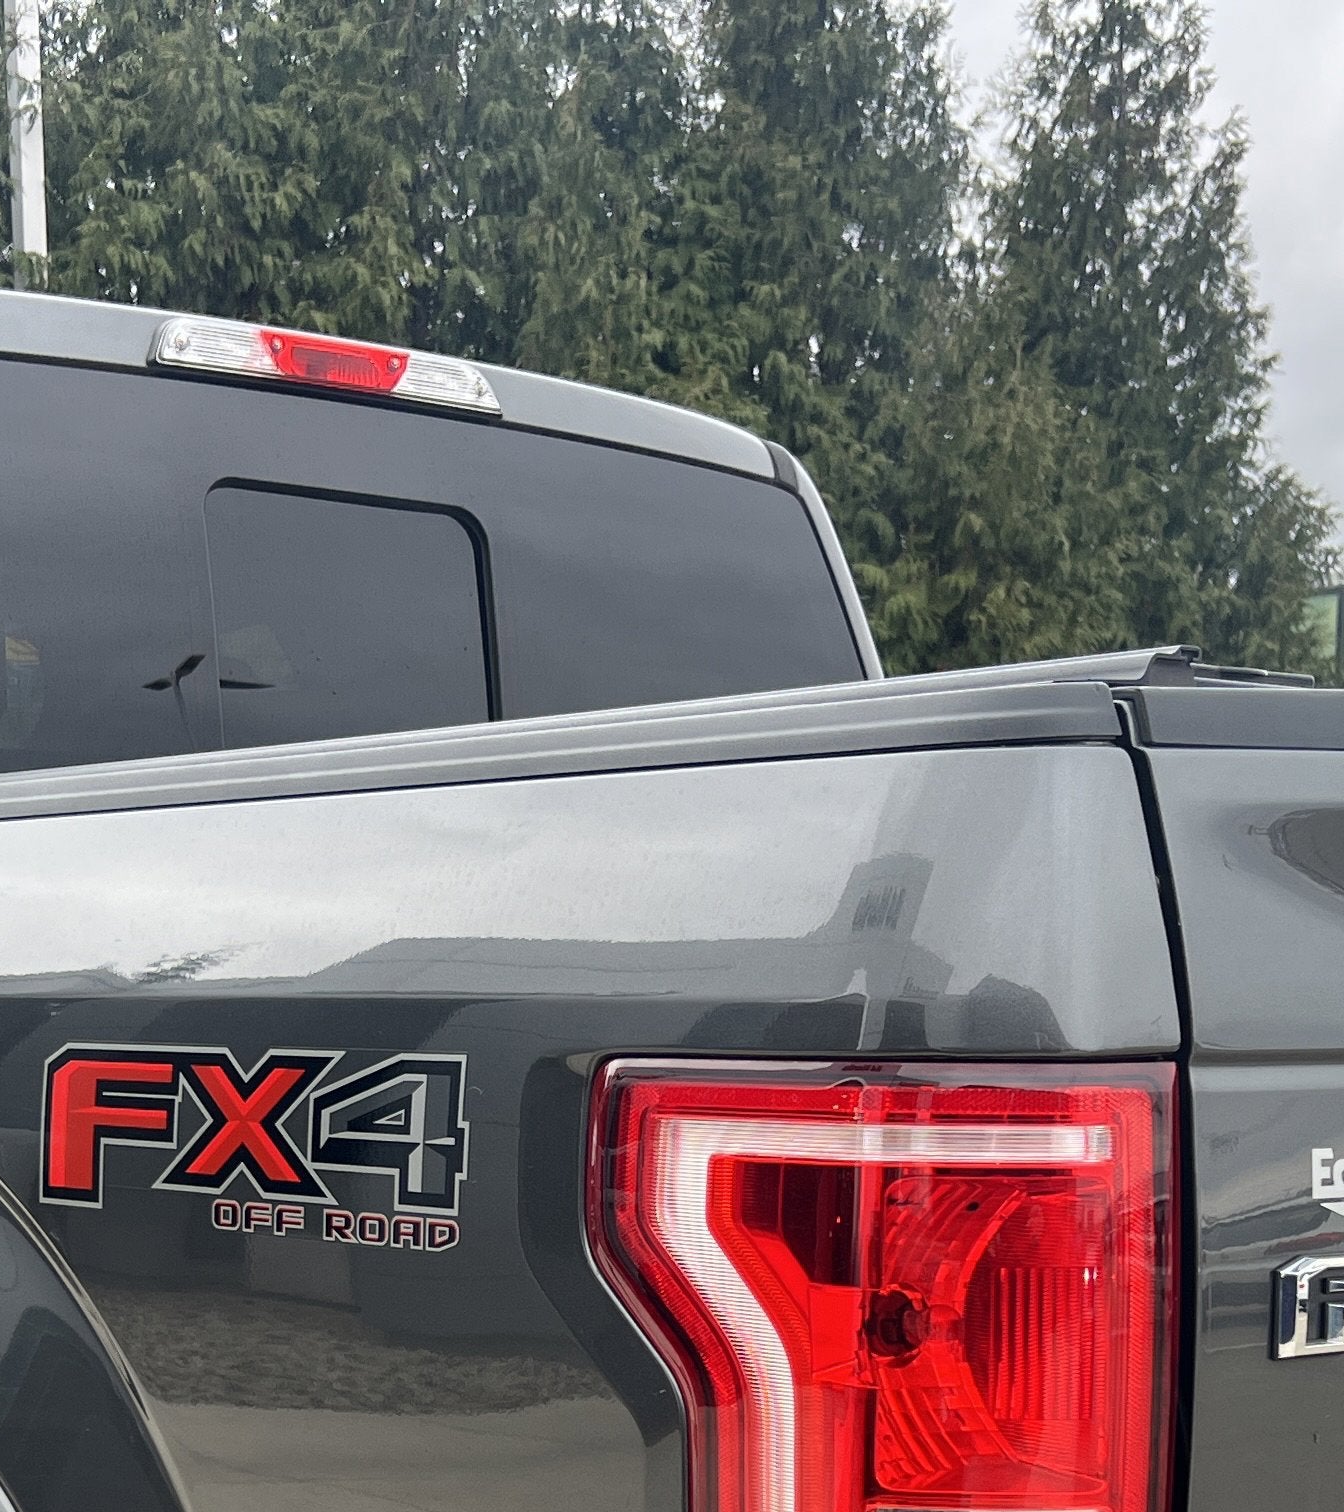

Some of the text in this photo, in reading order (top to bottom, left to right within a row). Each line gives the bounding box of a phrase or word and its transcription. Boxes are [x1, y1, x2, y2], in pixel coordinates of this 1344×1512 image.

[40, 1041, 470, 1216] FX4
[212, 1199, 460, 1252] OFF ROAD
